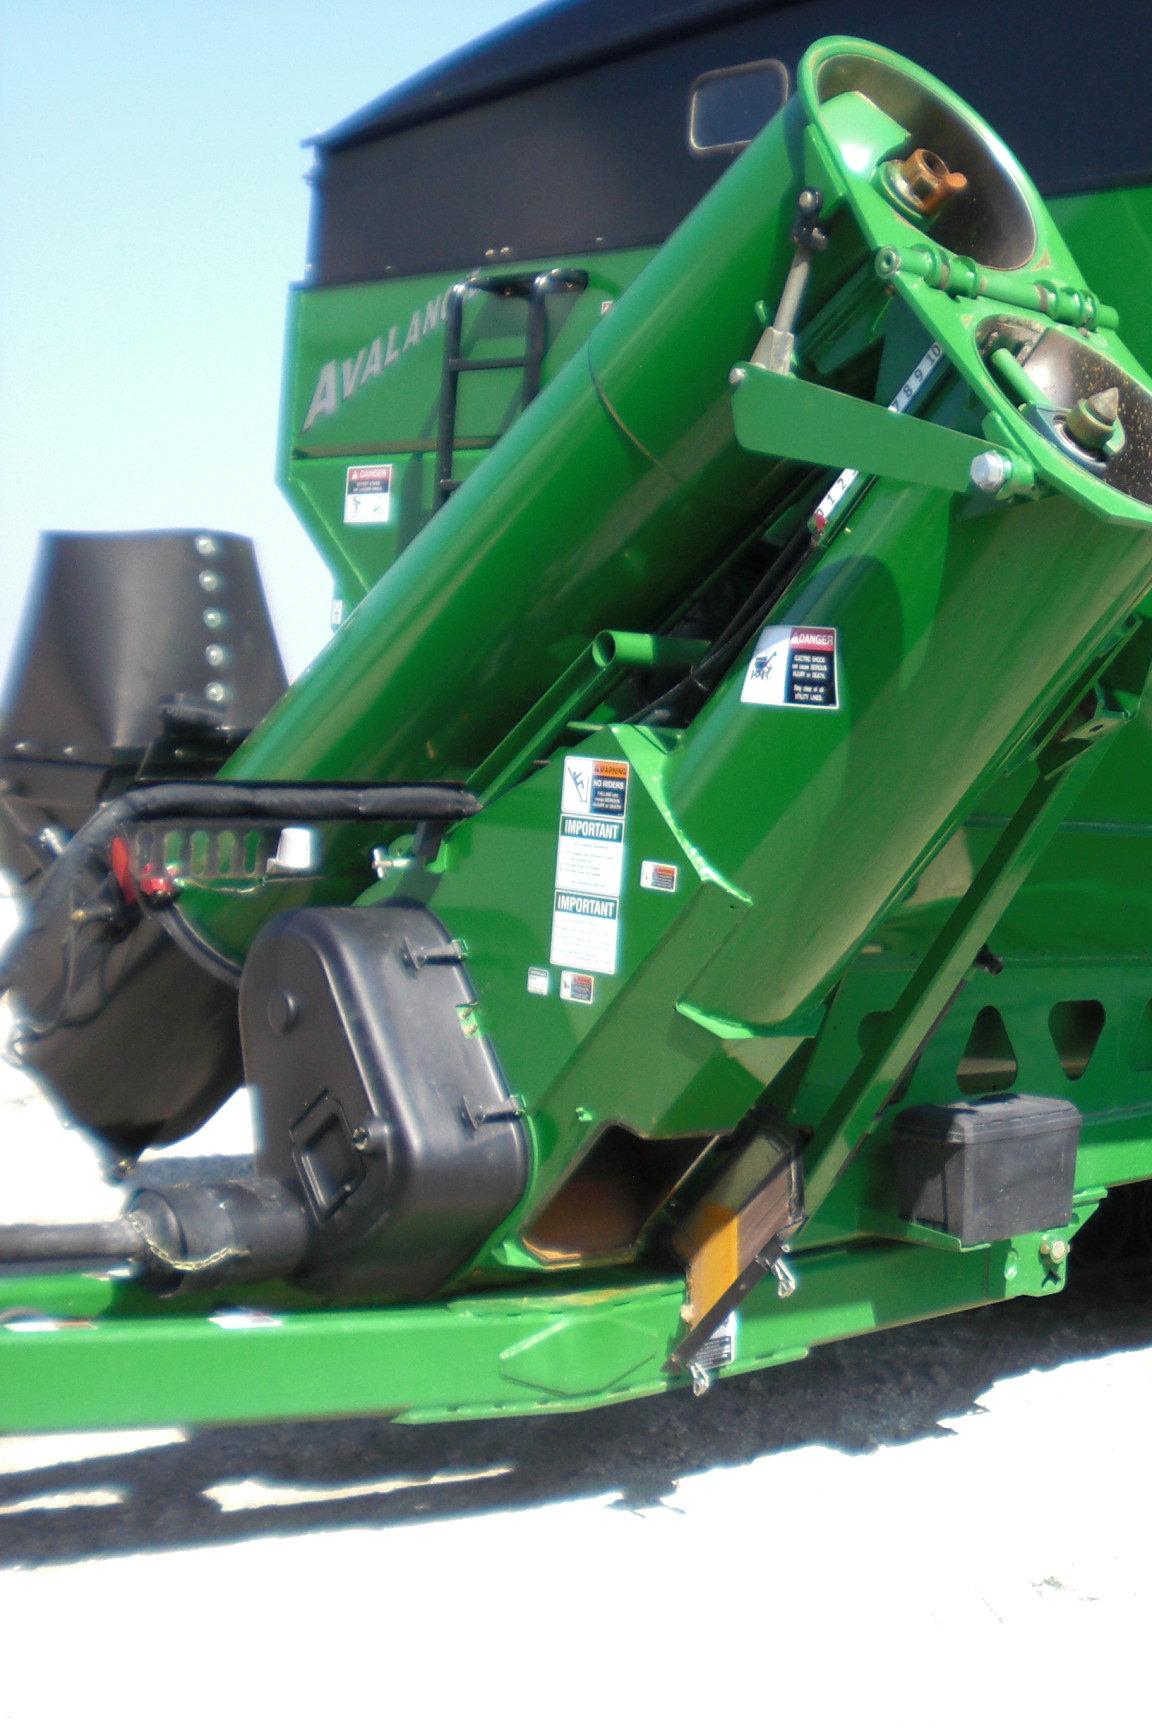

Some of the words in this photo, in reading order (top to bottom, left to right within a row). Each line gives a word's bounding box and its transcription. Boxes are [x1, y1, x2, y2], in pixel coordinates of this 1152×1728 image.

[902, 384, 913, 398] 8
[914, 369, 923, 382] 9
[926, 345, 940, 365] 10
[360, 469, 387, 479] DANGER
[837, 477, 847, 491] 2
[799, 633, 833, 646] DANGER
[600, 765, 625, 776] WARNING
[603, 780, 625, 789] RIDERS
[564, 819, 619, 839] IMPORTANT
[557, 894, 615, 917] IMPORTANT
